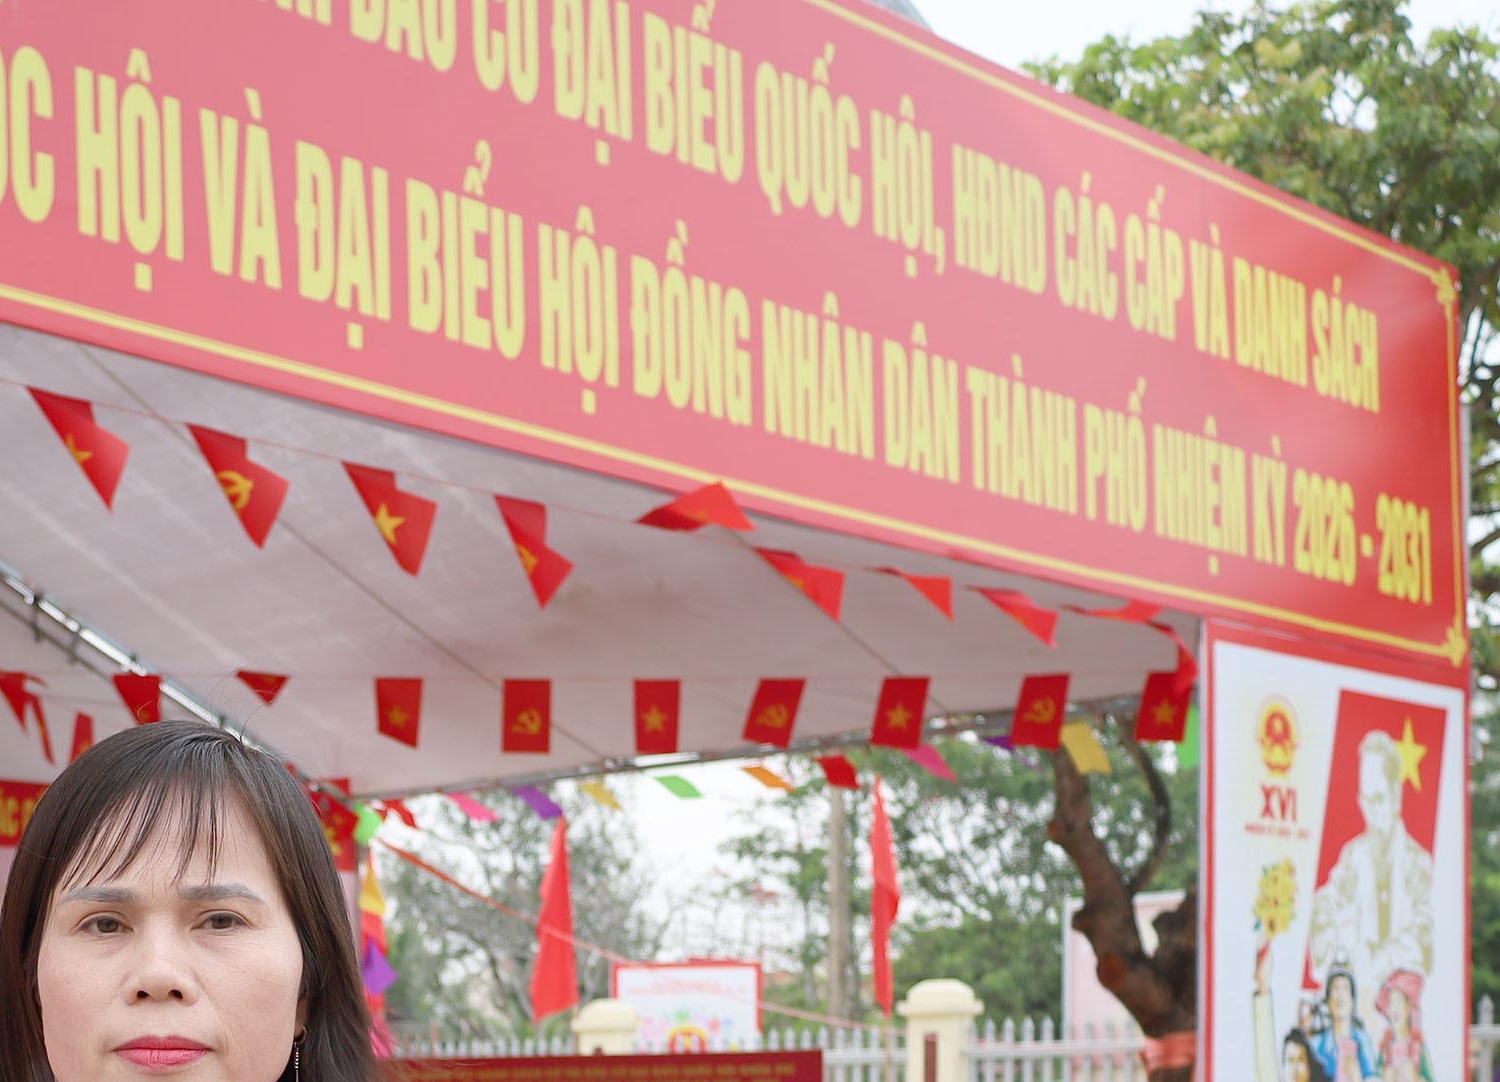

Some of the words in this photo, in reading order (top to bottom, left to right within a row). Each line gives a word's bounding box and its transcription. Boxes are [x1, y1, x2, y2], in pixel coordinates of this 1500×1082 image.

[74, 47, 185, 292] HỘI
[198, 86, 283, 291] VÀ
[296, 139, 391, 350] ĐẠI
[406, 139, 525, 360] BIỂU
[537, 205, 619, 415] HỘI
[631, 219, 752, 426] ĐỒNG
[762, 291, 874, 460] NHÂN
[883, 321, 959, 484] DÂN
[966, 353, 1078, 515] THÀNH
[1084, 376, 1147, 533] PHỐ
[1152, 414, 1248, 577] NHIỆM
[1252, 434, 1287, 567] KỲ
[1293, 466, 1357, 587] 2026
[1376, 492, 1432, 606] 2031
[754, 42, 863, 230] QUỐC
[869, 94, 946, 278] HỘI,
[952, 142, 1048, 296] HĐND
[1054, 170, 1120, 322] CÁC
[1125, 184, 1185, 342] CẤP
[1189, 222, 1230, 361] VÀ
[1233, 255, 1308, 389] DANH
[1311, 275, 1380, 413] SÁCH
[1259, 783, 1298, 822] XVI
